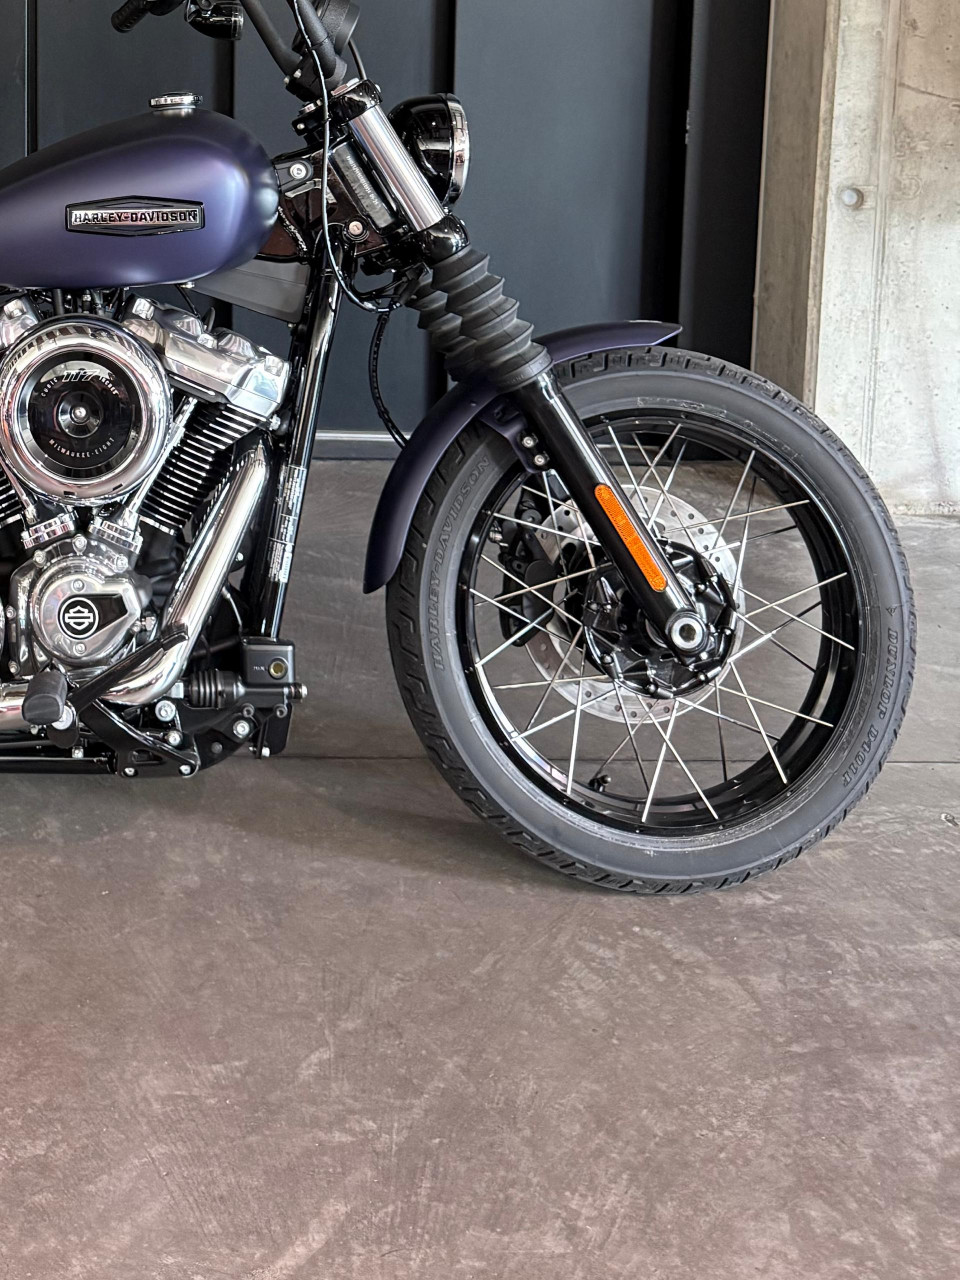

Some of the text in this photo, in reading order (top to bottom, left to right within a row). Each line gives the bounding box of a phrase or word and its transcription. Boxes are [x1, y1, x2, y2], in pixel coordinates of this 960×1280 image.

[74, 210, 198, 224] HARLEY-DAVIDSON
[430, 456, 491, 671] HARLEY-DAVIDSON
[877, 628, 898, 720] DUNLOP
[841, 724, 879, 788] D401F
